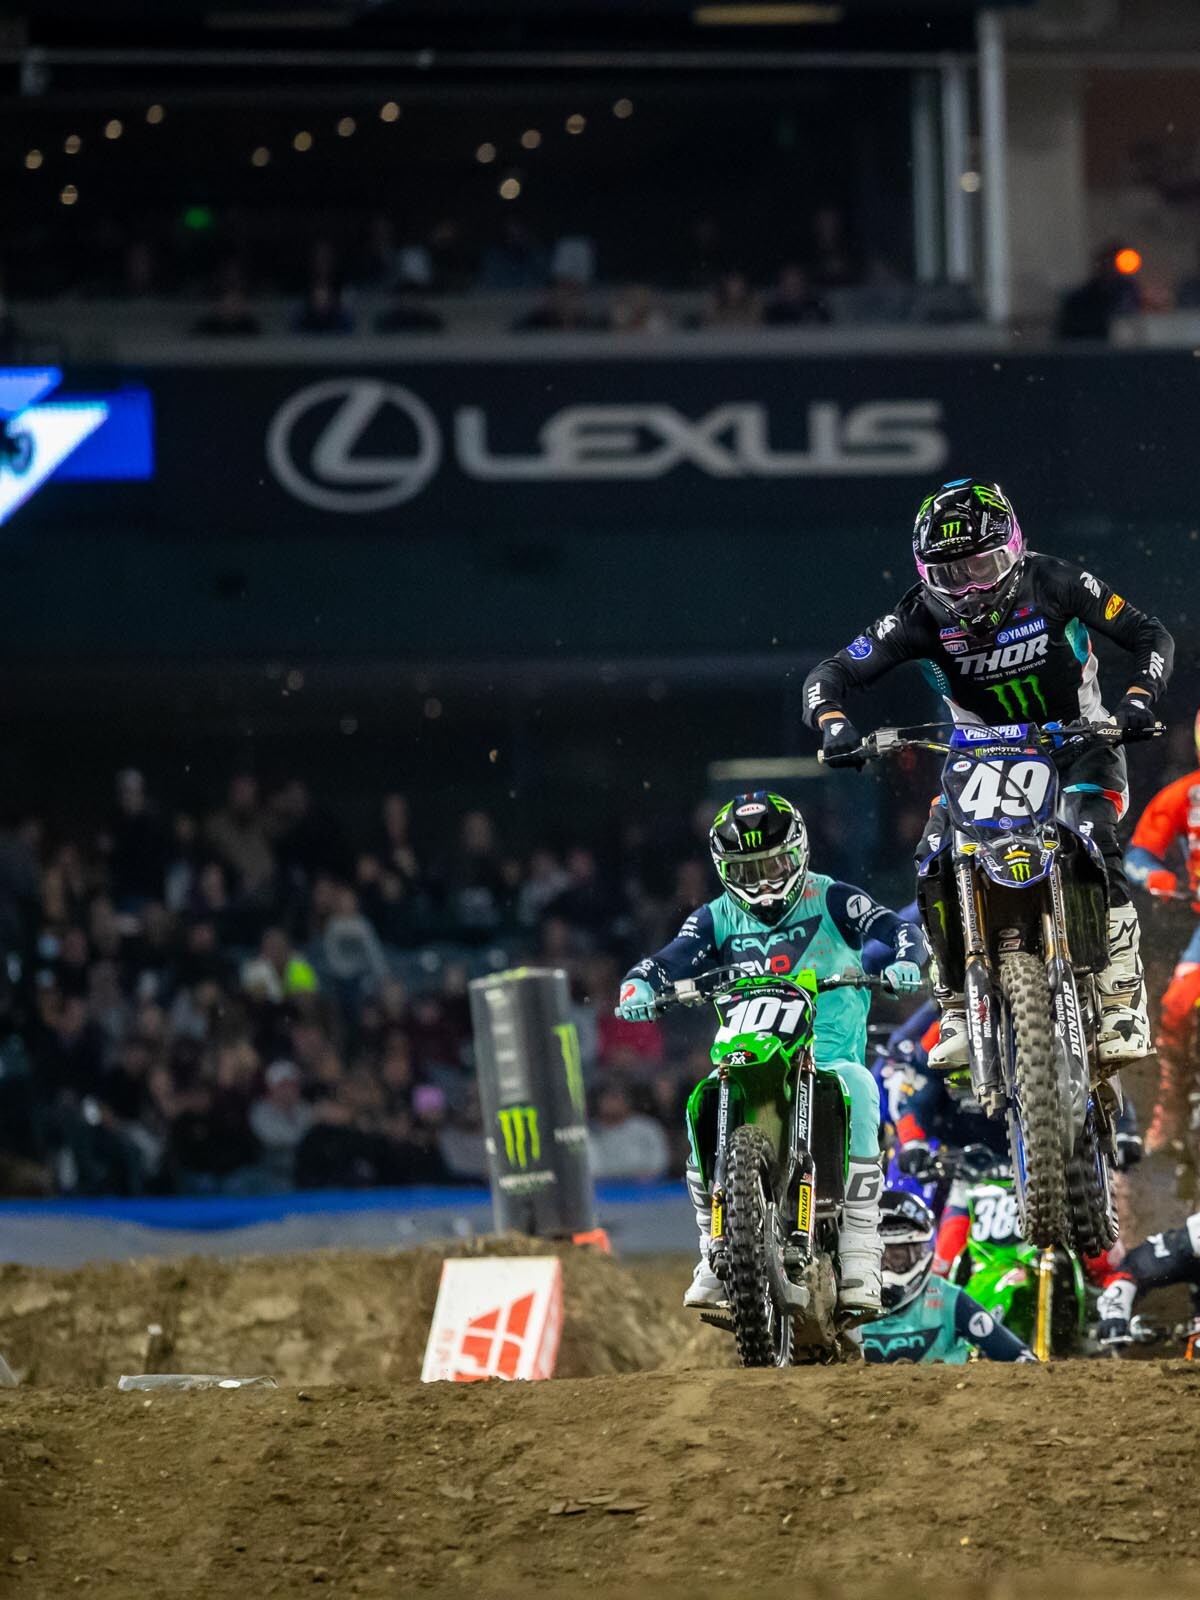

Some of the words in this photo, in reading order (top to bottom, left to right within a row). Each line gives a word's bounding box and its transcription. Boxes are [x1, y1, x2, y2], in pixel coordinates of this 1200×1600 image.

[456, 401, 949, 480] LEXUS
[954, 634, 1048, 674] THOR
[1005, 668, 1018, 676] THE
[1018, 659, 1047, 675] FOREVER
[958, 760, 1050, 820] 49
[849, 895, 862, 915] 7
[726, 997, 806, 1035] 101
[968, 985, 984, 1062] DUNLOP
[1063, 981, 1082, 1059] DUNLOP
[800, 1081, 809, 1120] CIRCUIT
[799, 1120, 808, 1140] PRO
[801, 1187, 809, 1227] DUNLOP
[972, 1198, 1023, 1243] 38
